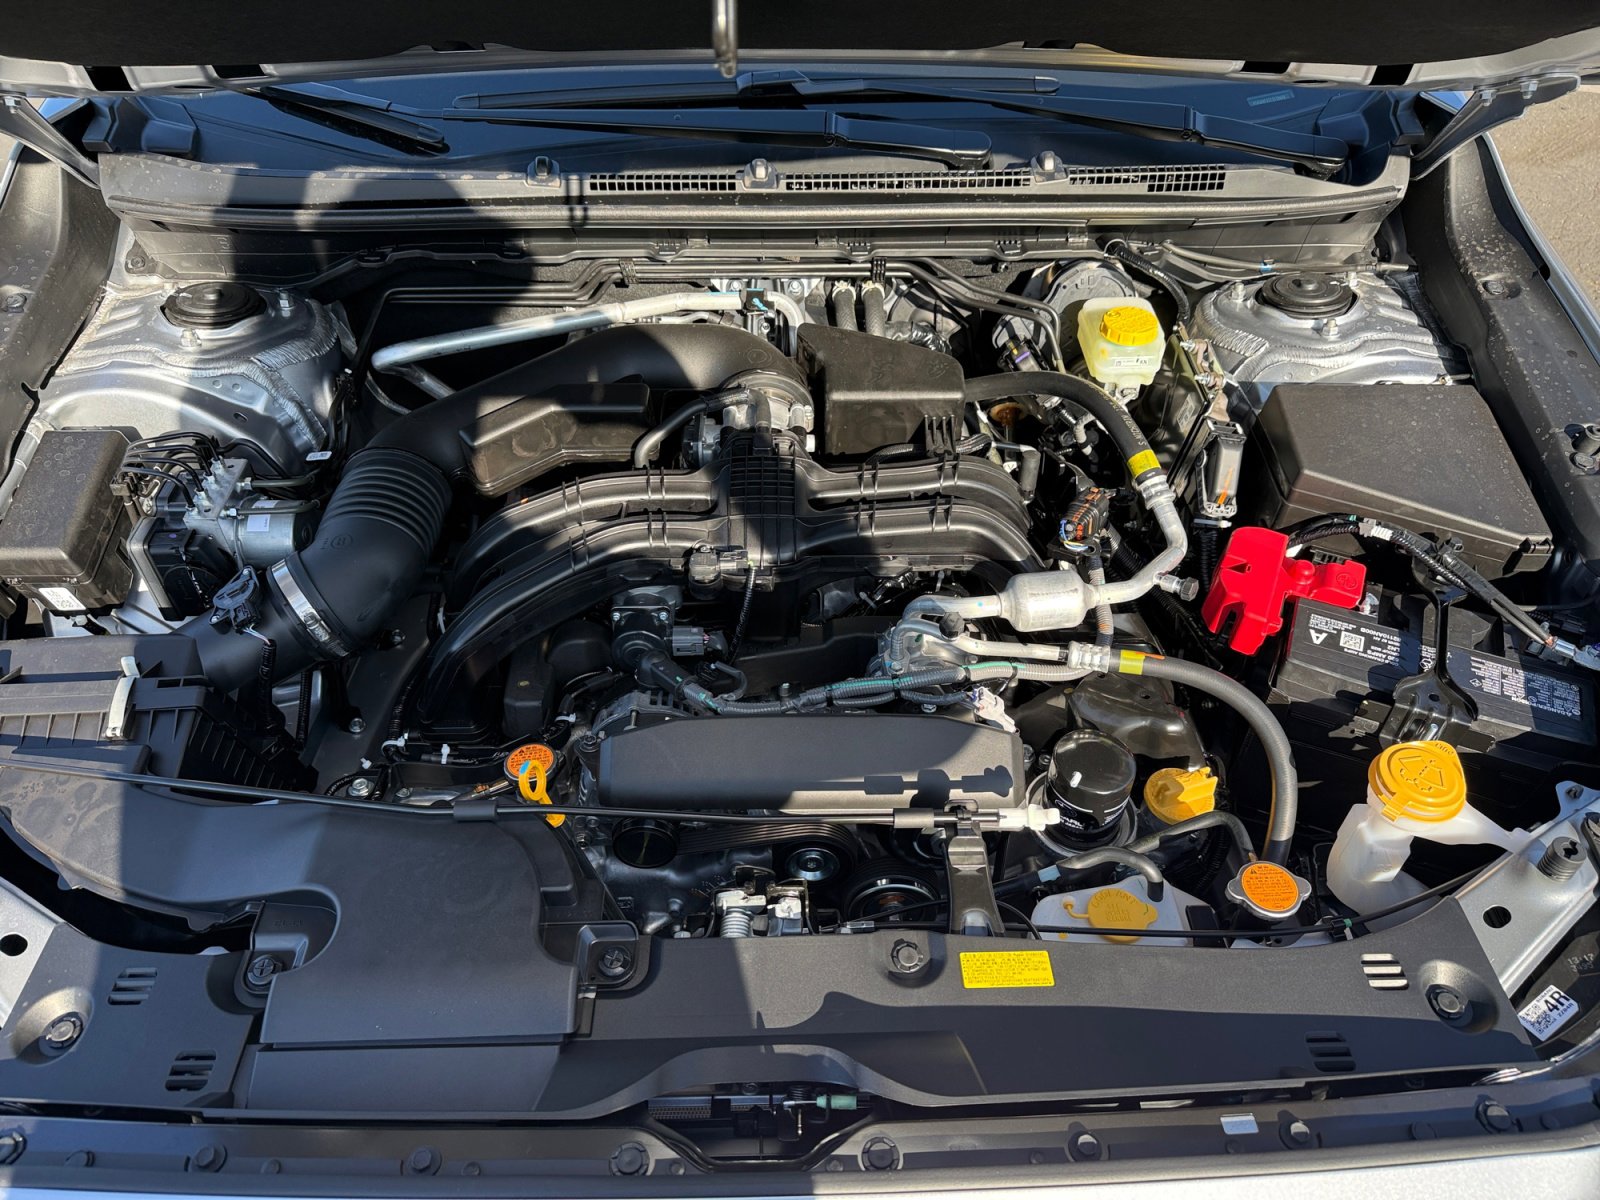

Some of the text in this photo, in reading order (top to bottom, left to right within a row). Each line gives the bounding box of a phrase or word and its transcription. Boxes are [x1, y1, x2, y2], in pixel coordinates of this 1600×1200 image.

[1309, 628, 1328, 645] A
[1387, 644, 1400, 652] LN2
[1358, 652, 1385, 663] CRANKING
[1366, 649, 1387, 659] AMPS
[1544, 990, 1570, 1013] 4R
